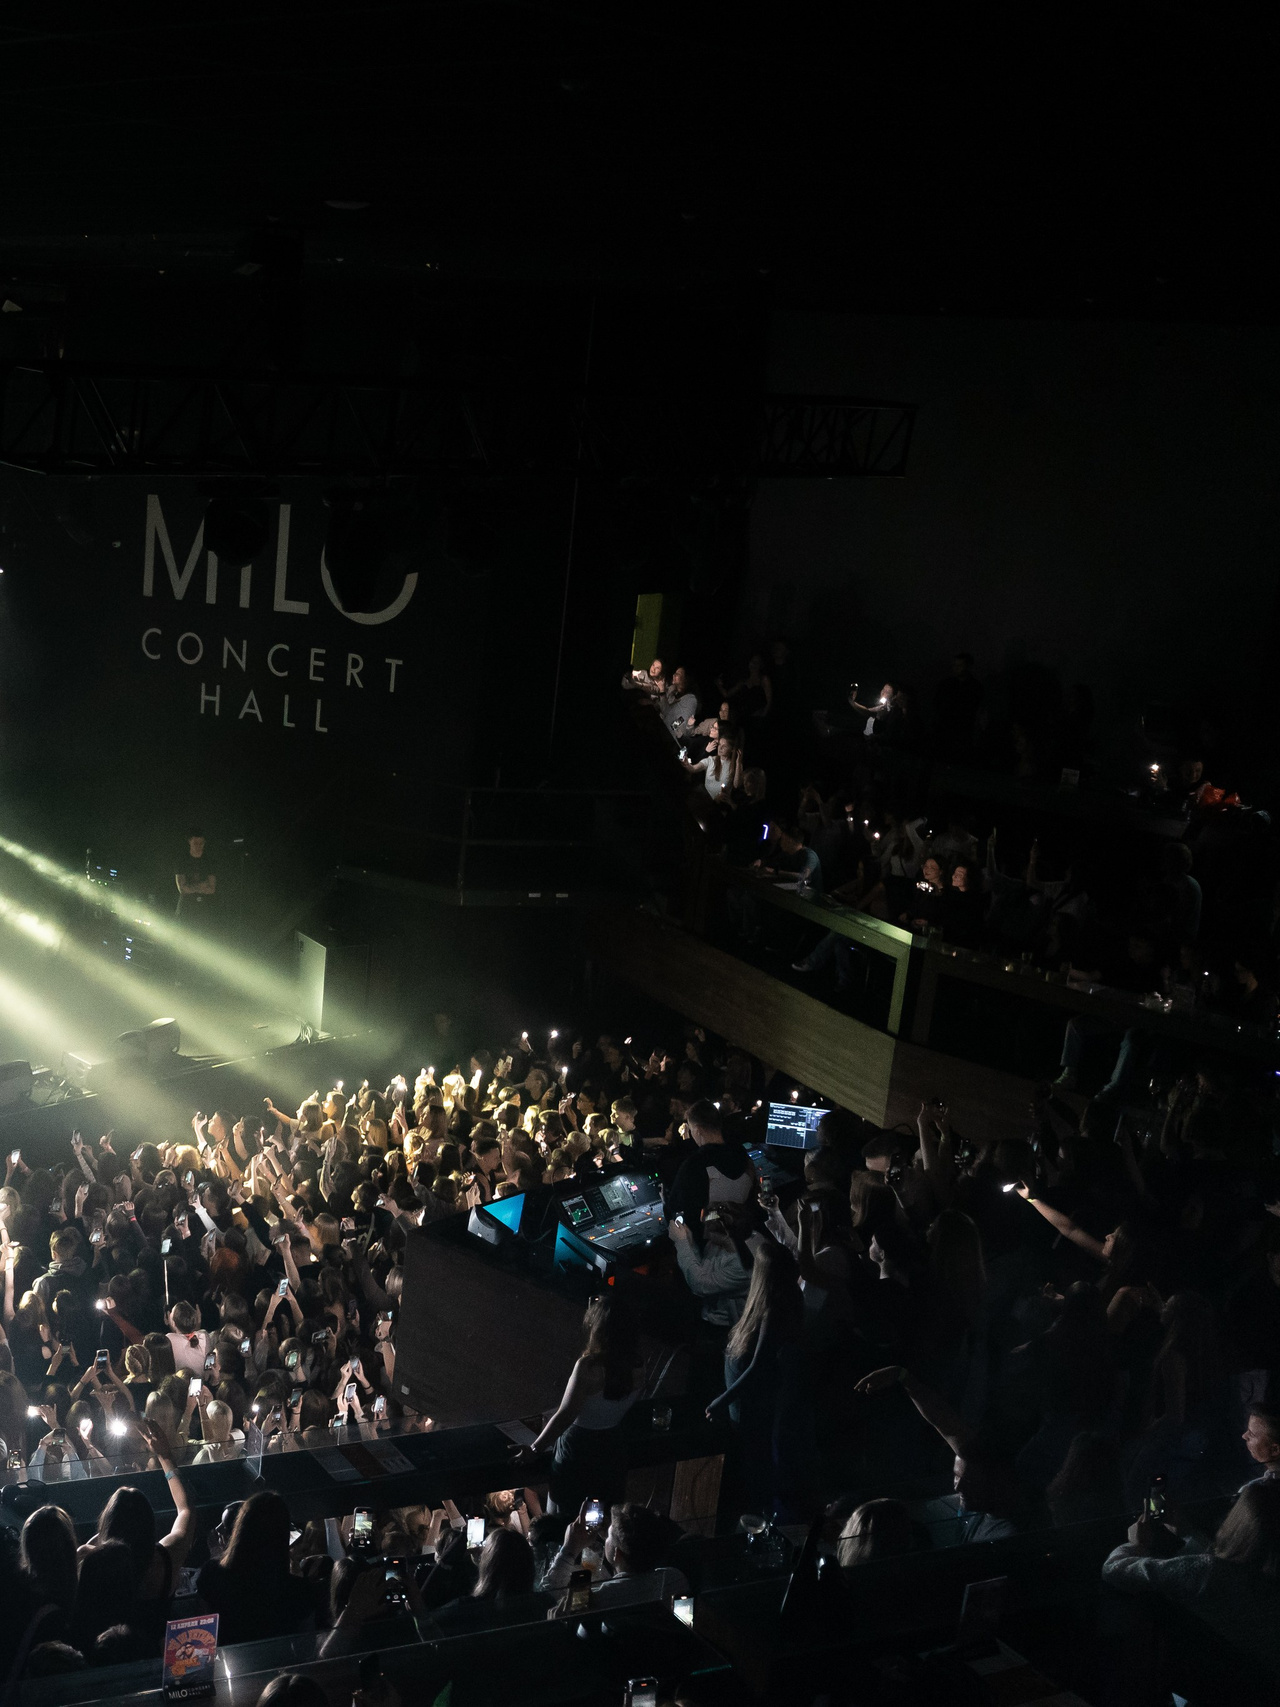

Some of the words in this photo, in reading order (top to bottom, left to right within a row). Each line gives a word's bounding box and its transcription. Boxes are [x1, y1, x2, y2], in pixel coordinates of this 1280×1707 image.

[141, 627, 404, 693] CONCERT
[200, 682, 328, 733] HALL
[168, 1689, 188, 1699] MILO
